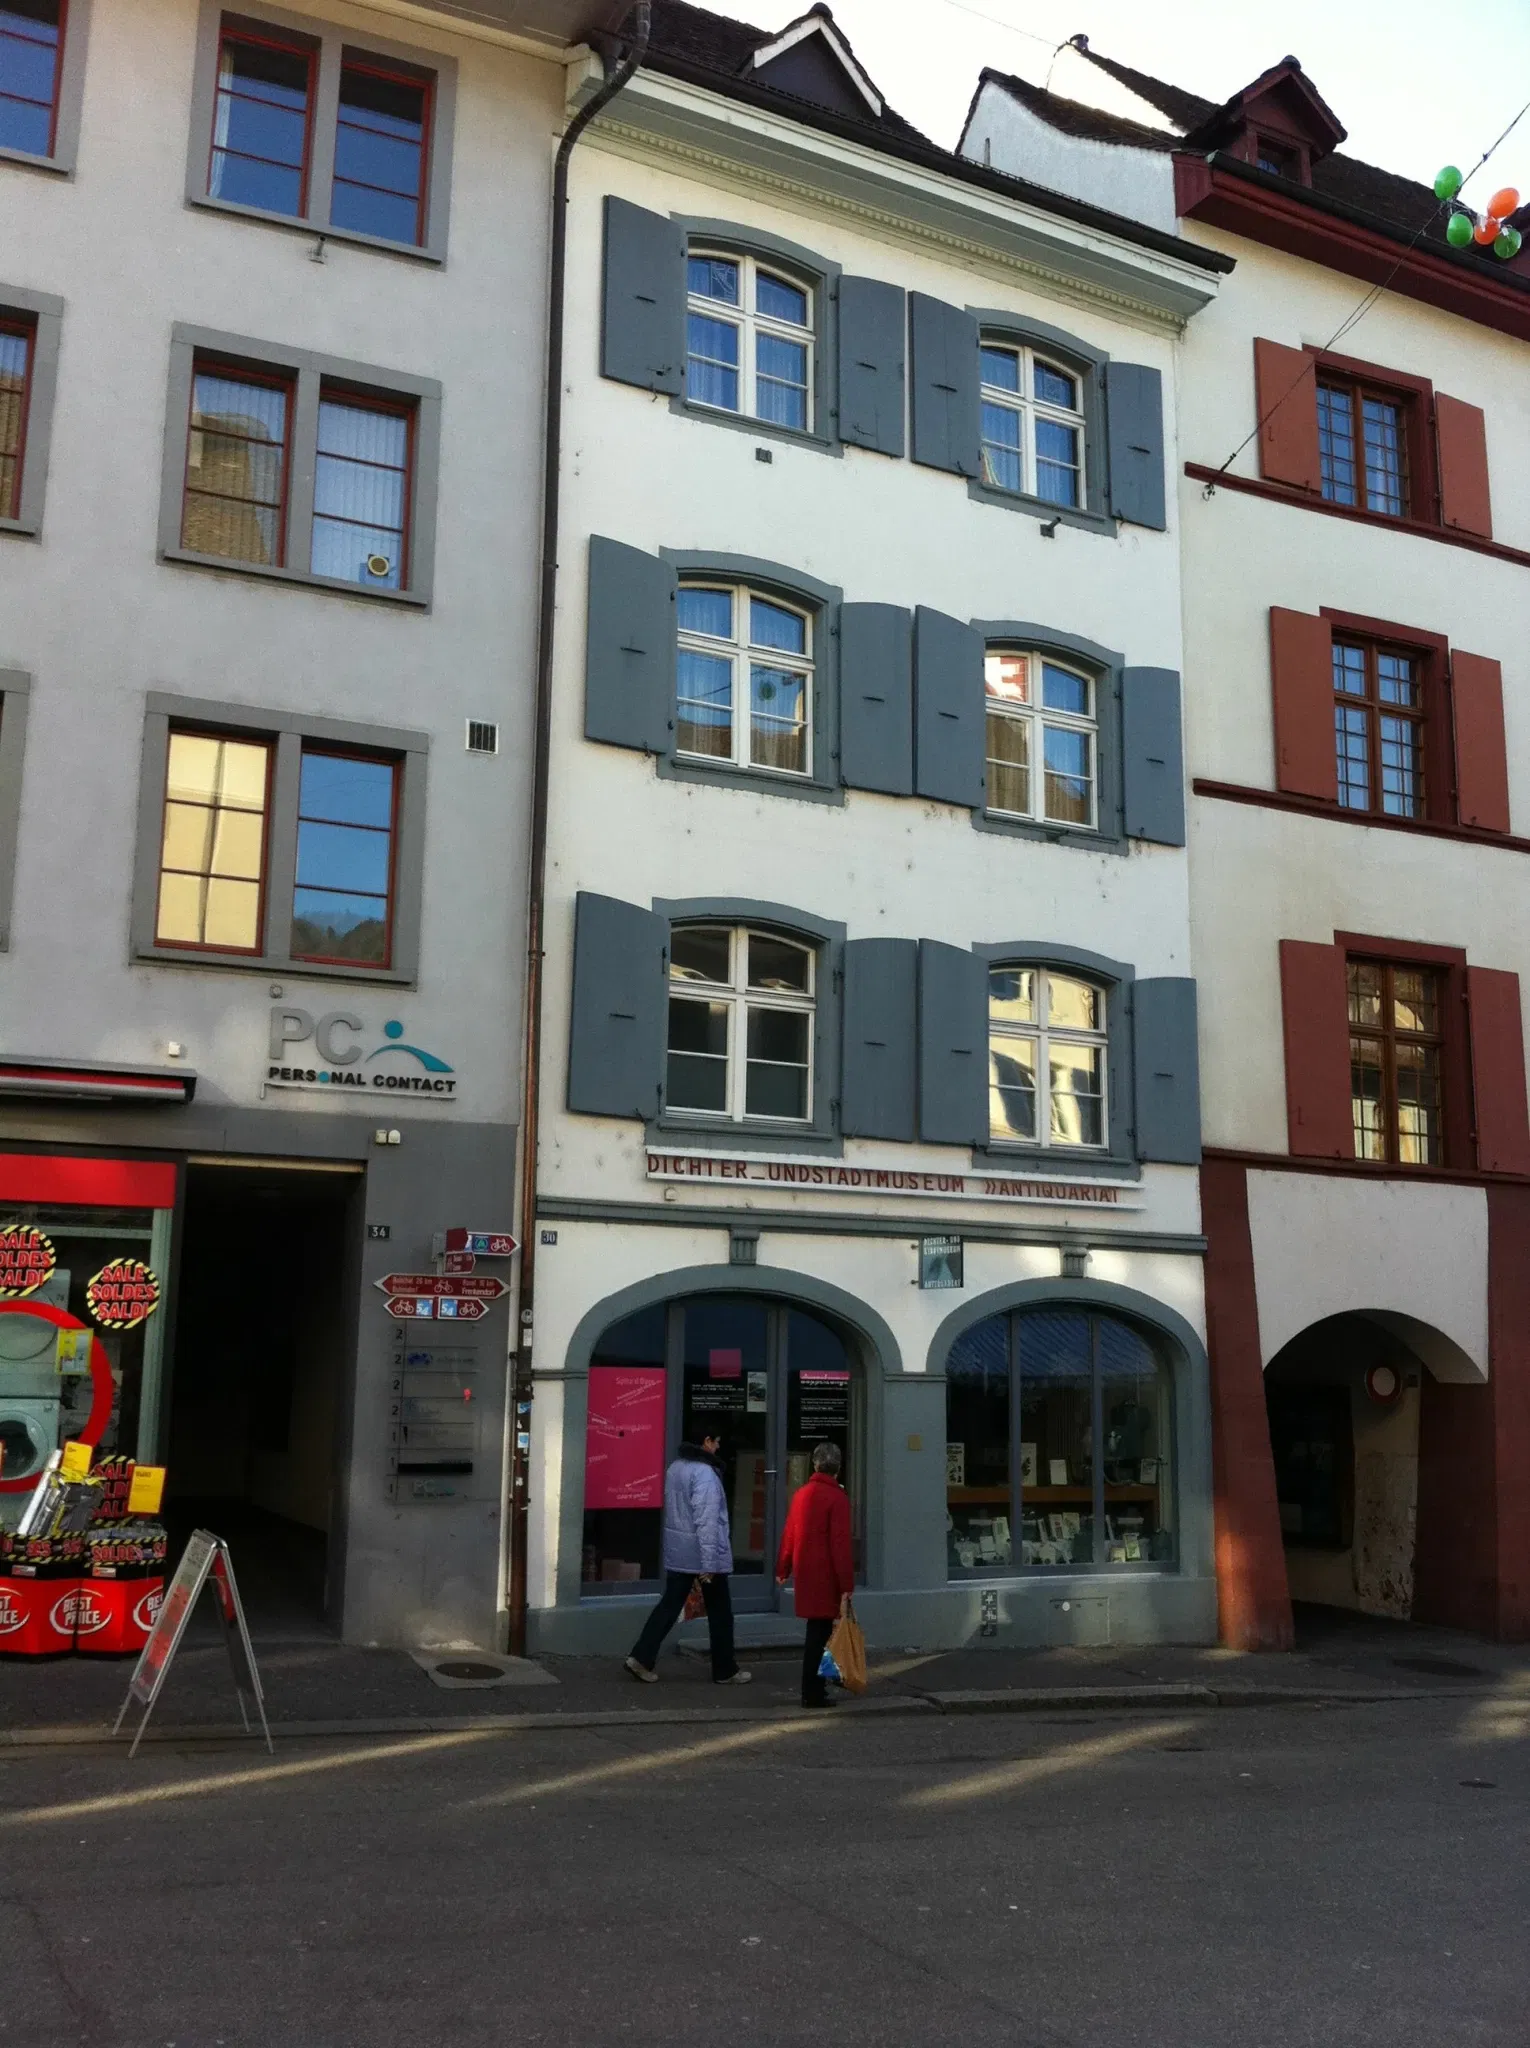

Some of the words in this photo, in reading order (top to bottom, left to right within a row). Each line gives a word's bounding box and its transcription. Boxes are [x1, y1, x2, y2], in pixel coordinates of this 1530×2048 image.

[269, 1006, 364, 1066] PC
[268, 1066, 367, 1087] PERSONAL
[373, 1074, 457, 1093] CONTACT
[0, 1232, 41, 1249] SALE
[371, 1226, 386, 1238] 34
[542, 1231, 557, 1244] 30
[0, 1250, 52, 1268] OLDES
[102, 1265, 145, 1283] SALE
[90, 1284, 156, 1301] SOLDES
[98, 1302, 149, 1320] SALDI
[394, 1354, 402, 1365] 2
[393, 1380, 400, 1390] 2
[391, 1406, 399, 1416] 2
[91, 1544, 144, 1562] SOLDES
[63, 1596, 93, 1613] BEST
